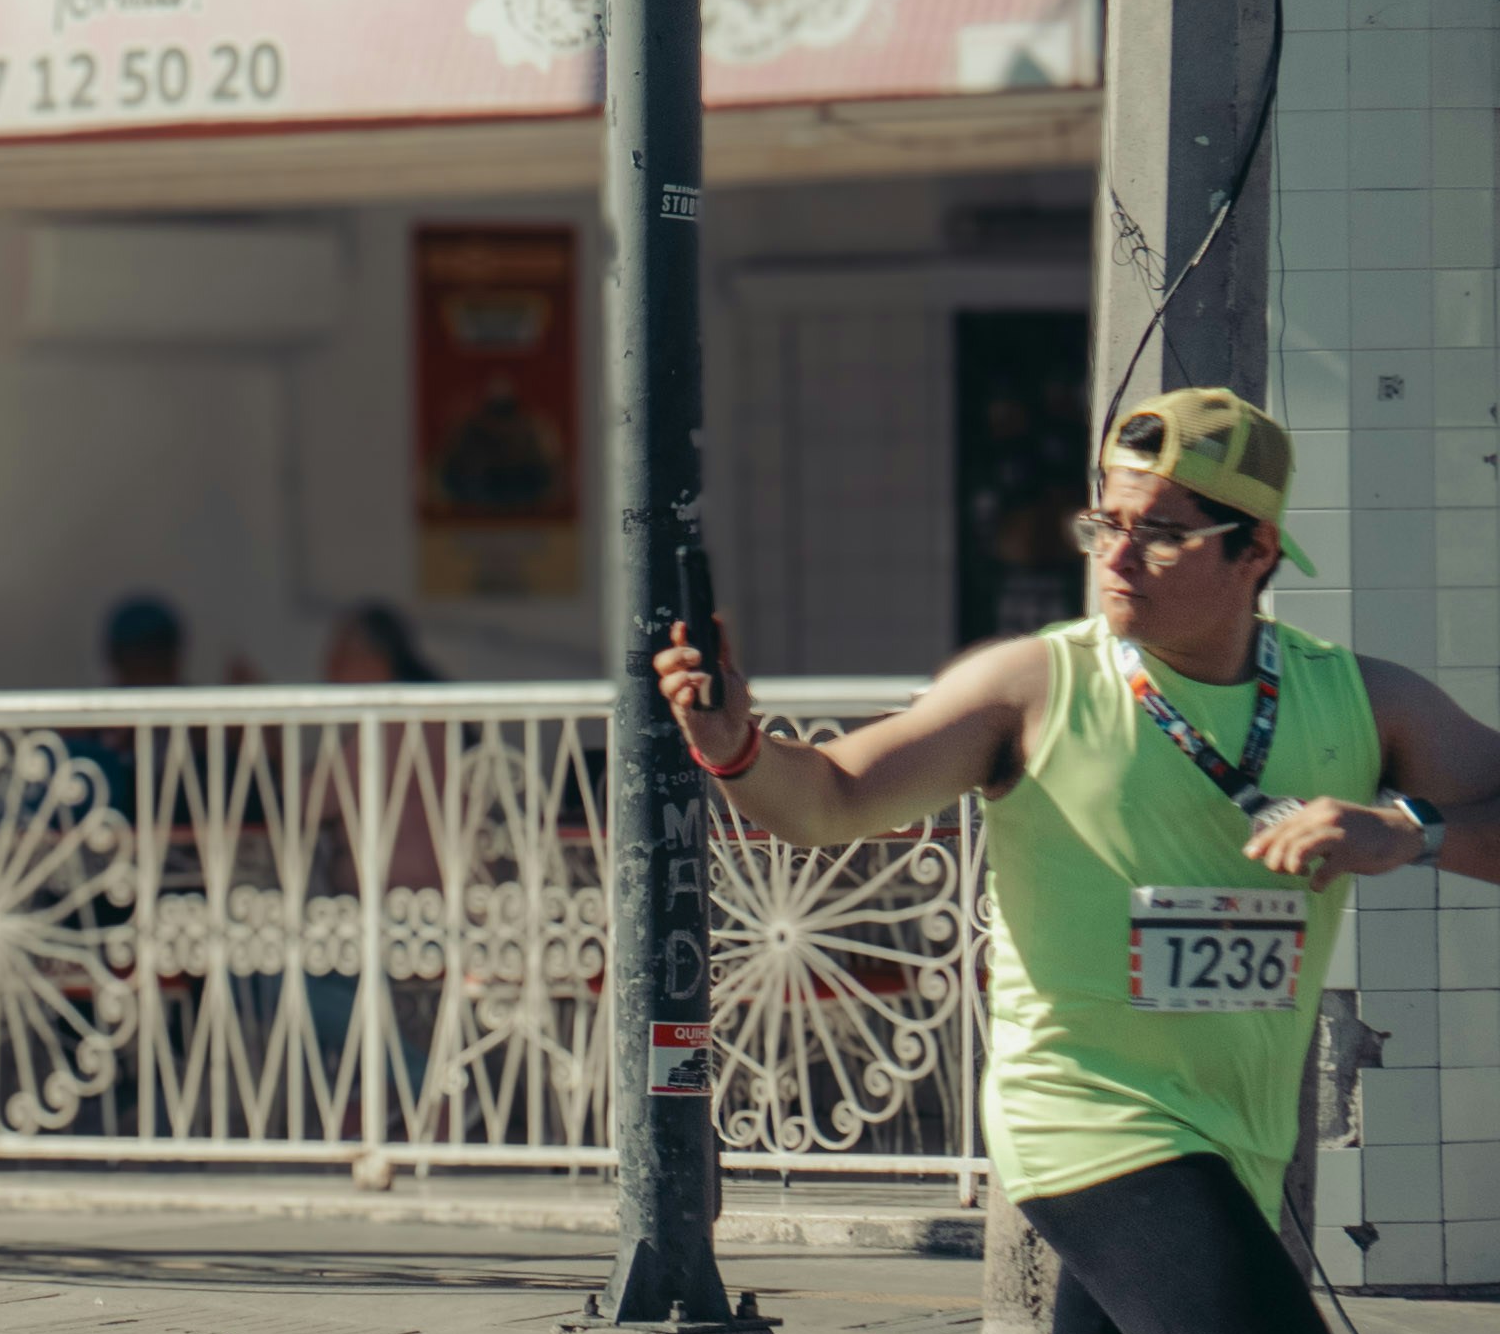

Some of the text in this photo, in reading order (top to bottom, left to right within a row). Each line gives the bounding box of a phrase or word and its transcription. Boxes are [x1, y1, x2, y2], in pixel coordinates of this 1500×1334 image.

[34, 53, 97, 112] 12
[120, 46, 192, 108] 50
[211, 42, 283, 103] 20
[1166, 936, 1286, 990] 1236
